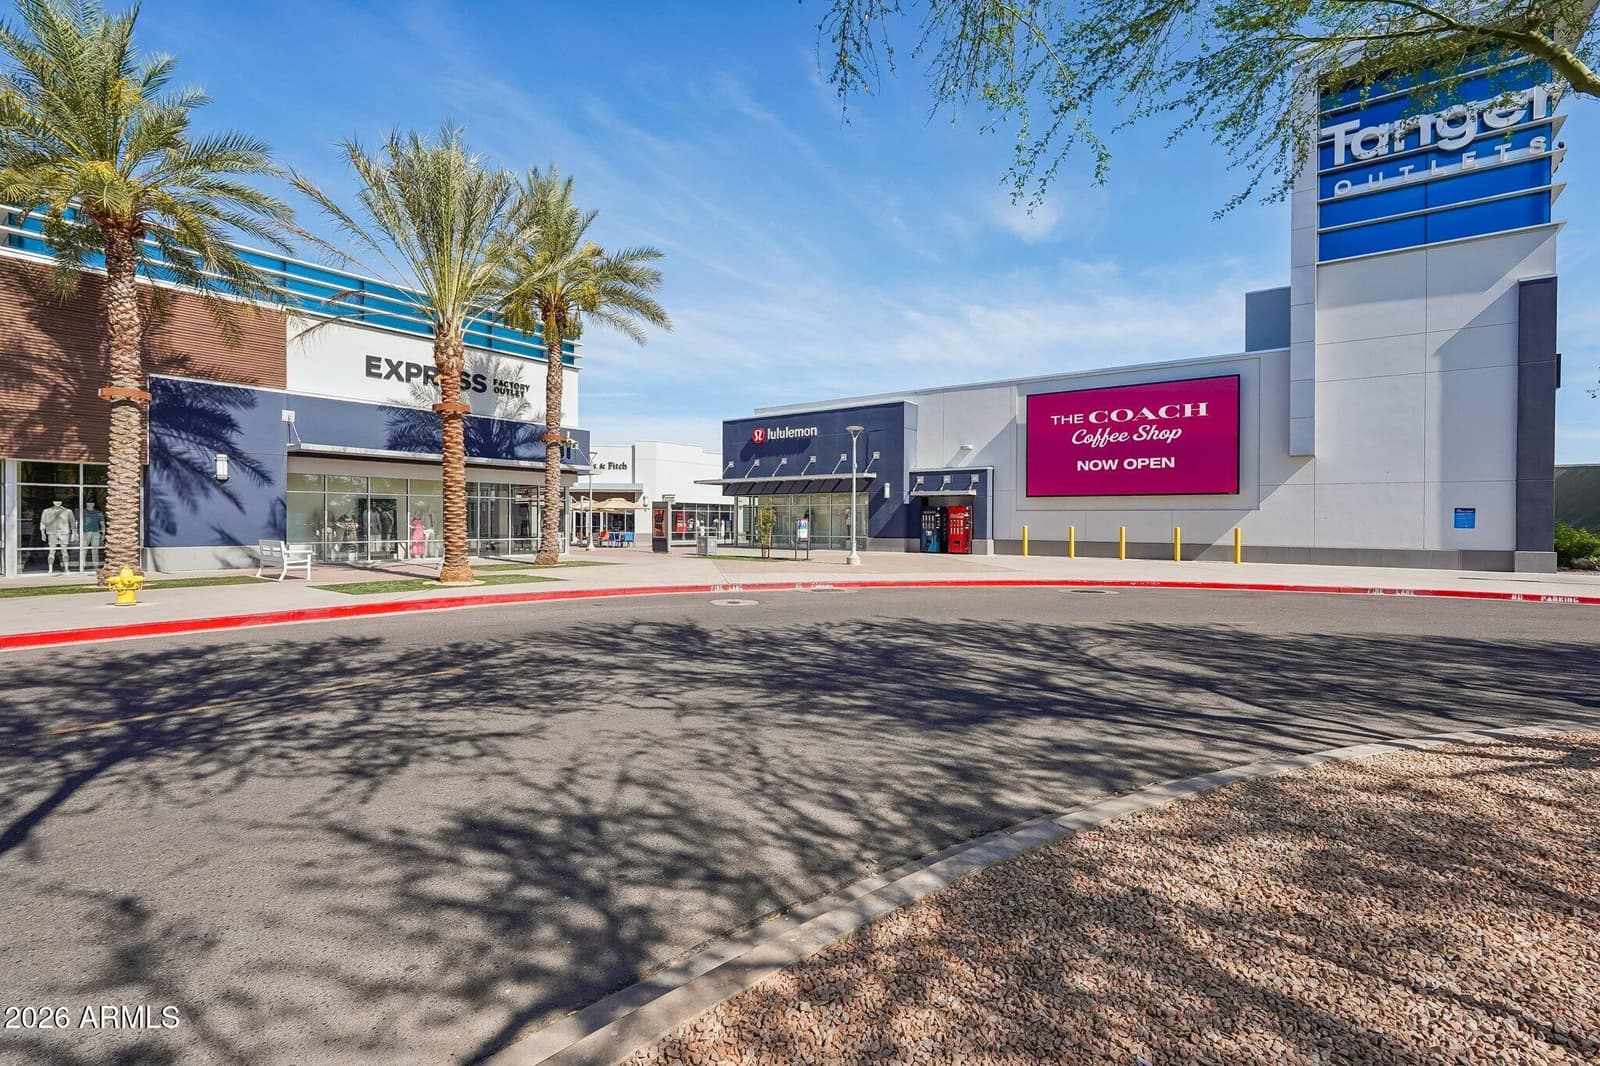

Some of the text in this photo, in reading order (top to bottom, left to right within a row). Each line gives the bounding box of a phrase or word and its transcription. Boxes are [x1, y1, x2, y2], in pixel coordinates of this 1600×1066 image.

[1333, 135, 1547, 198] OUTLETS
[365, 354, 488, 394] EXPRSS
[493, 378, 531, 393] FACTORY
[493, 387, 525, 398] OUTLET
[1050, 401, 1209, 426] THE COACH
[767, 426, 818, 440] lululemon
[1072, 424, 1182, 448] Coffee Shop
[607, 461, 628, 470] Fitch
[1076, 456, 1176, 472] NOW OPEN
[1540, 594, 1579, 604] PARKING
